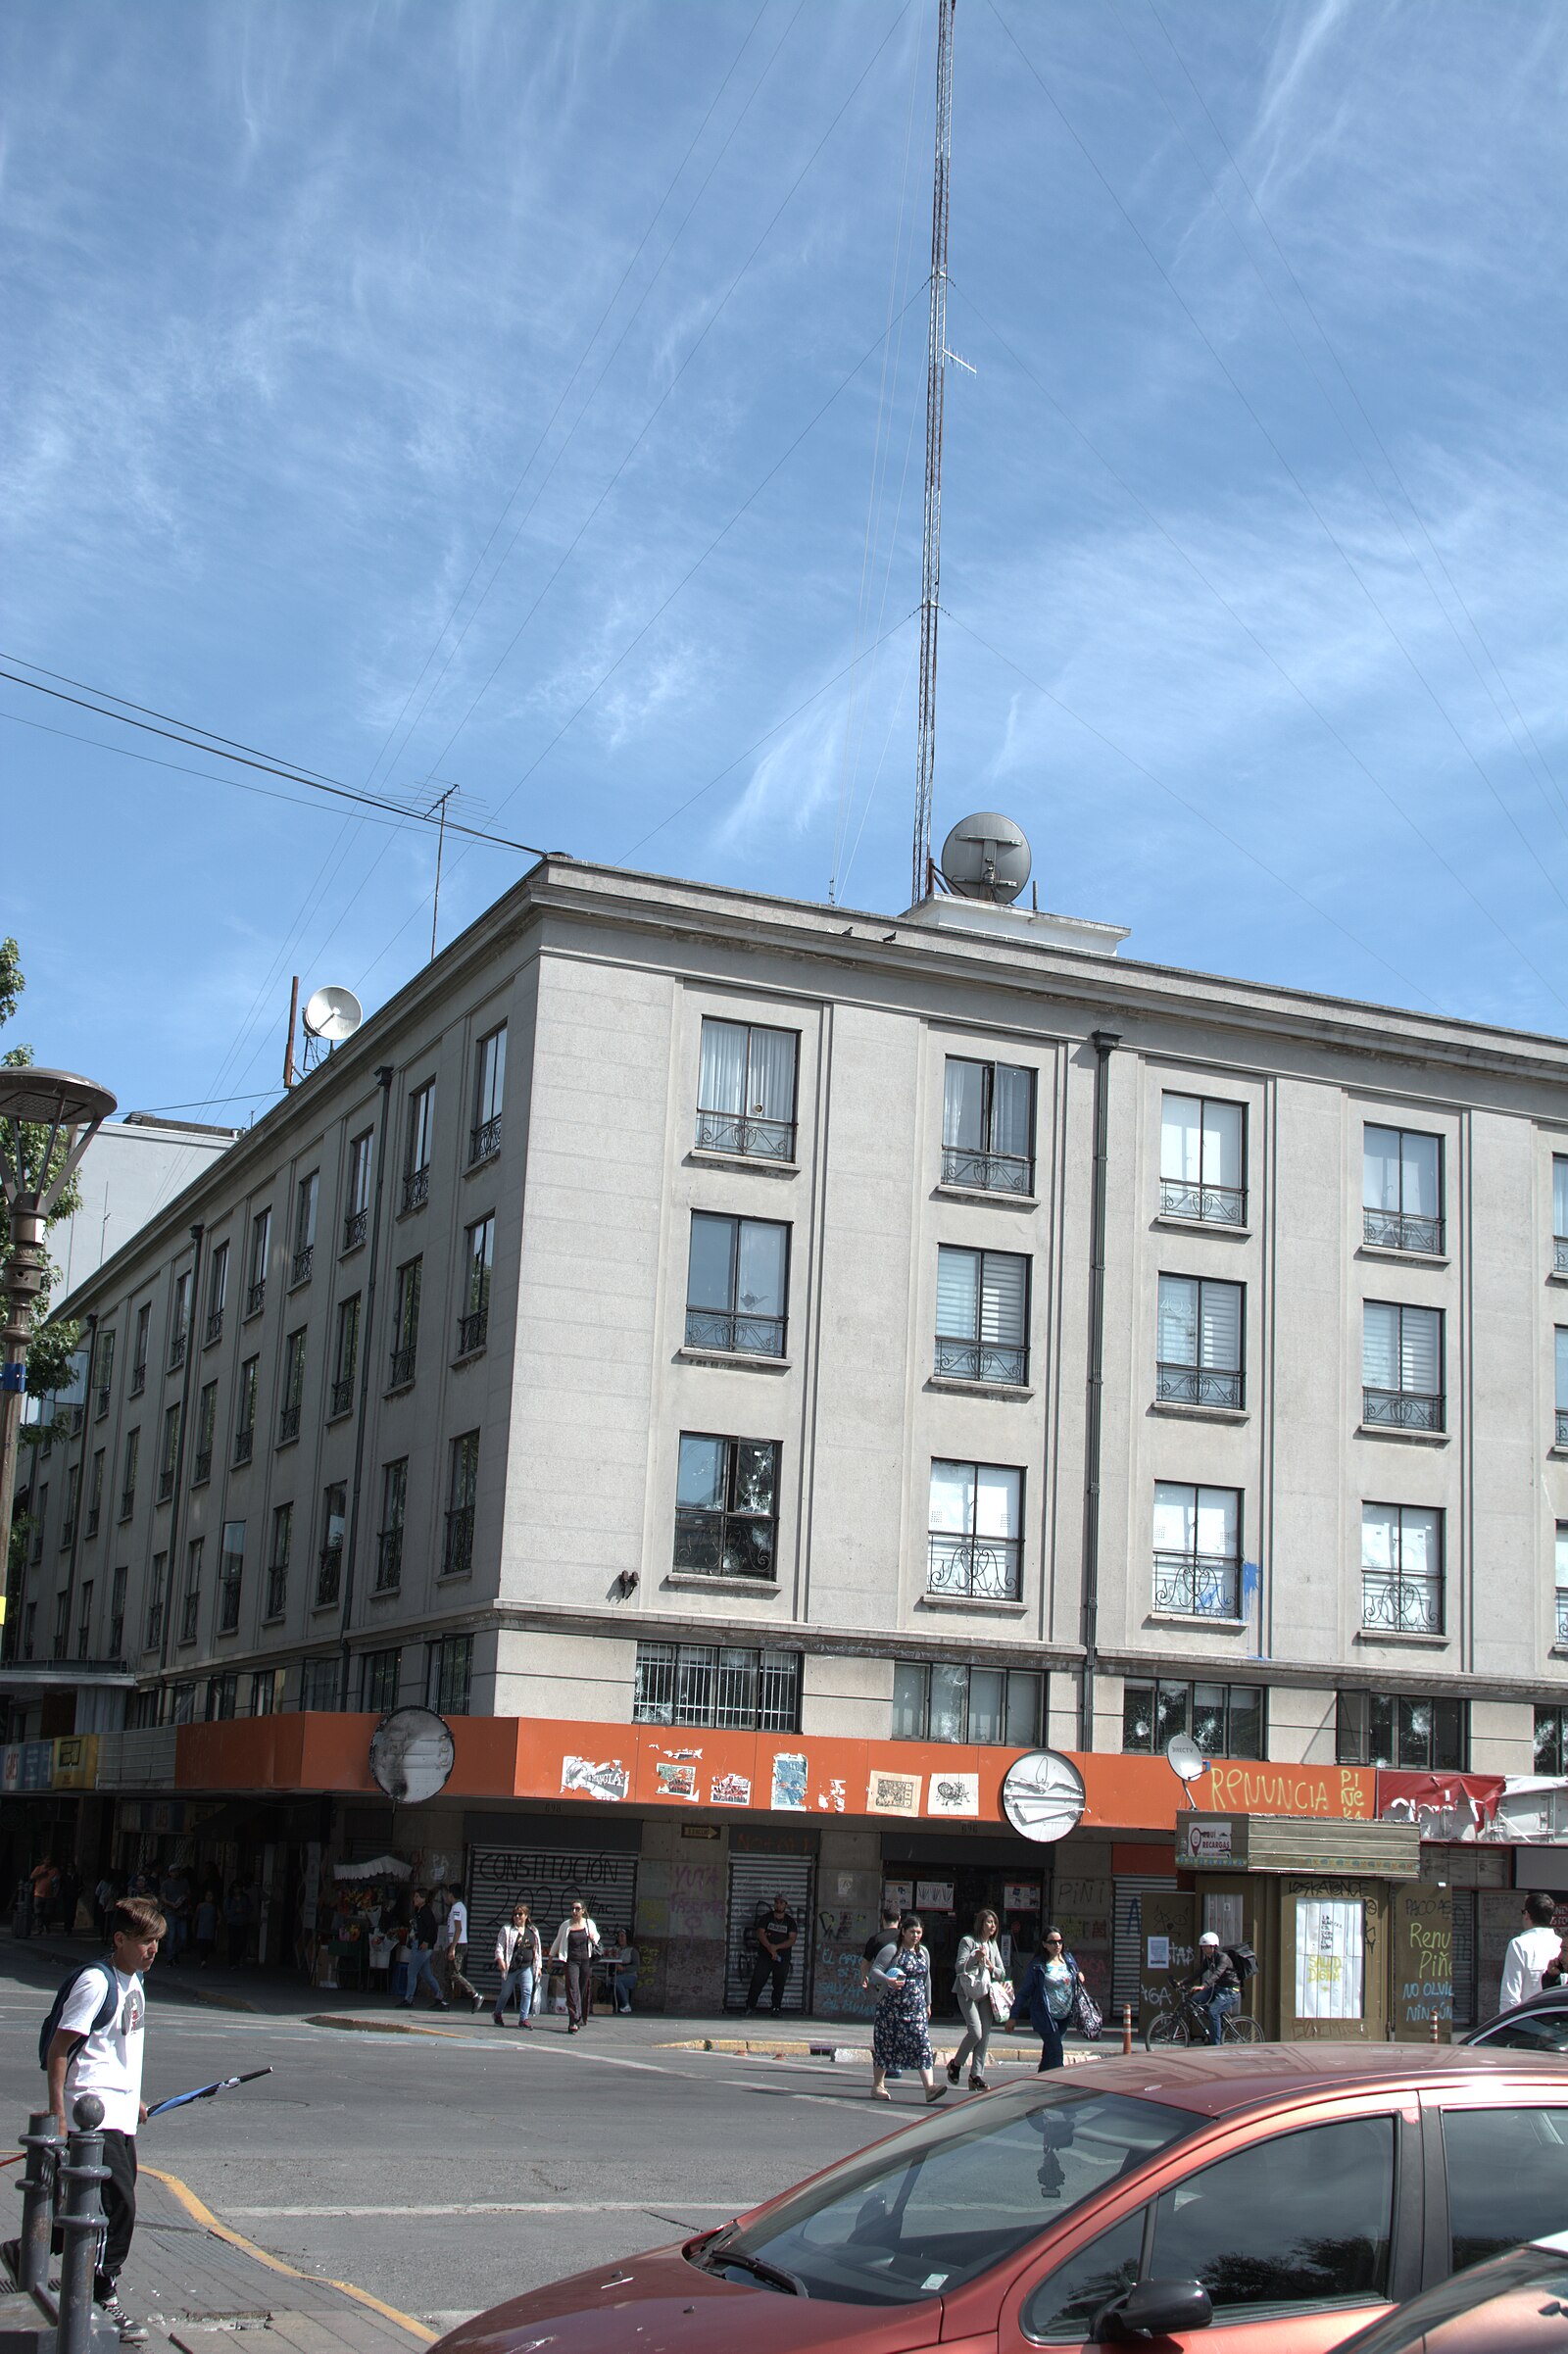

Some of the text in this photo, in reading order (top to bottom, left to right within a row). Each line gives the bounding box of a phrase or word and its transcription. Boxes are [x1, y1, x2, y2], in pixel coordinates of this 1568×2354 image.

[1202, 1841, 1231, 1850] RECARGAS
[479, 1851, 619, 1884] CONSTITUCIÓN
[1308, 1955, 1343, 1969] SALUD
[1402, 1983, 1419, 2000] NO
